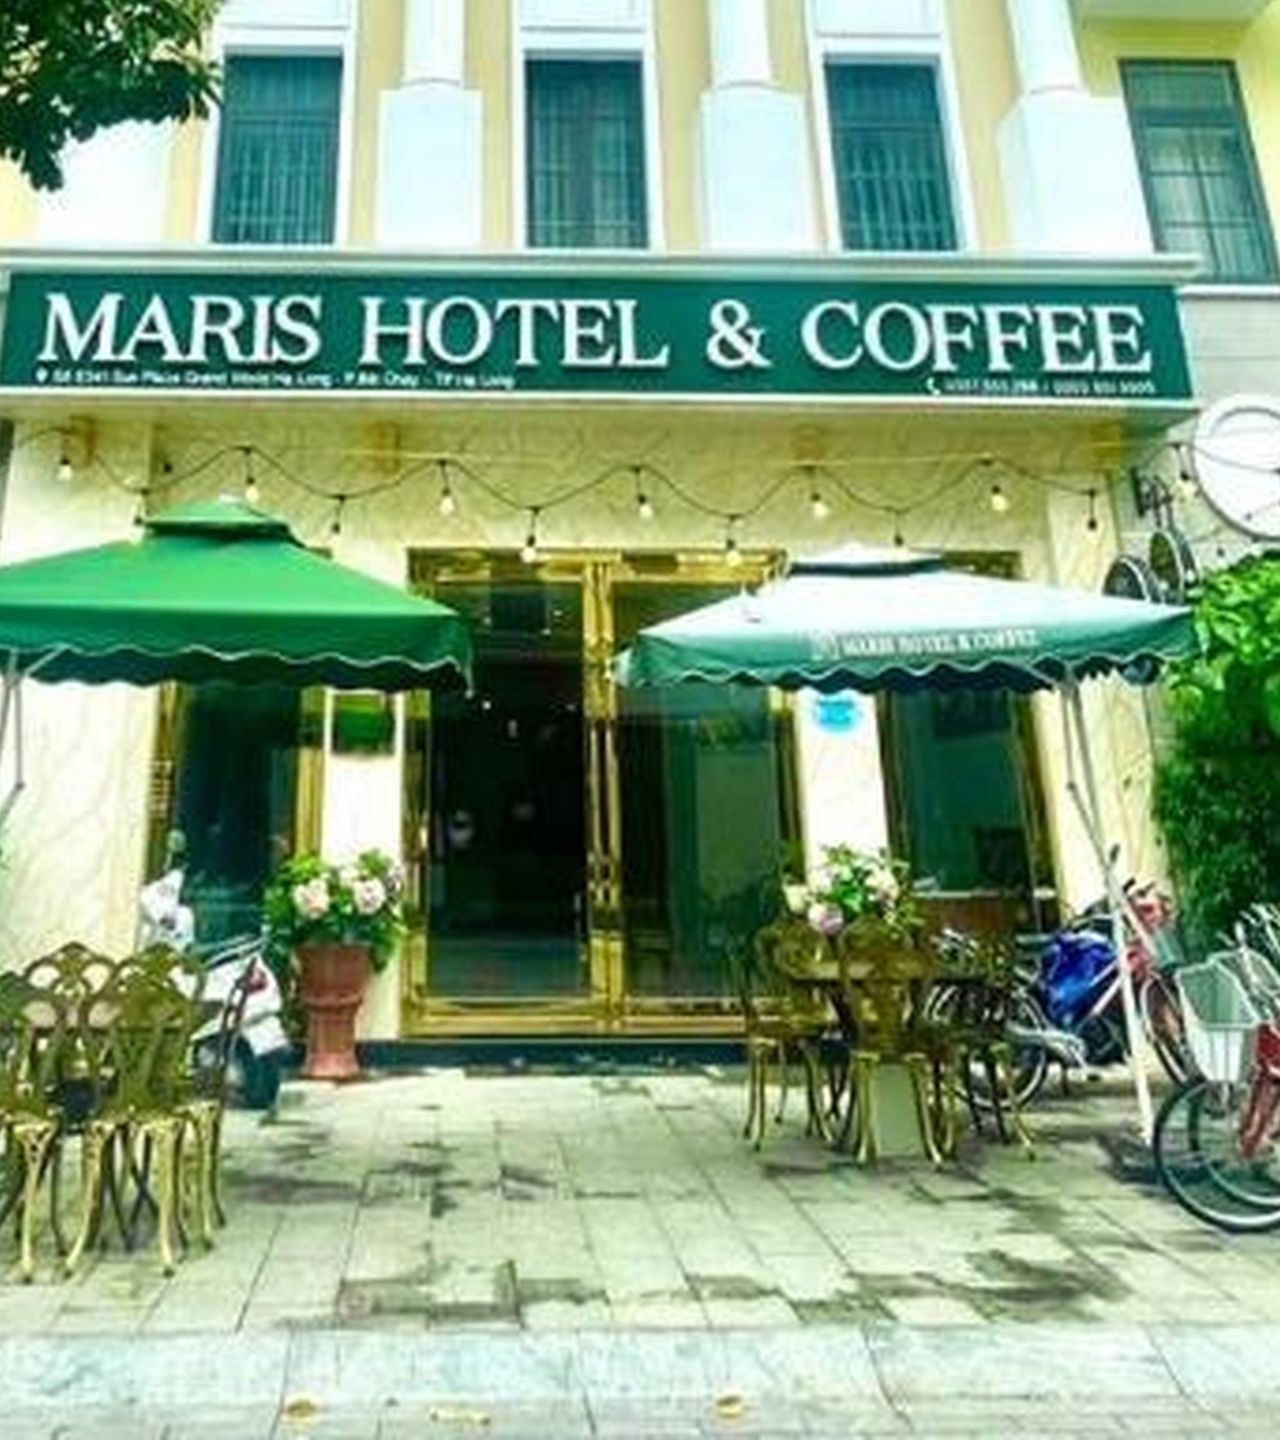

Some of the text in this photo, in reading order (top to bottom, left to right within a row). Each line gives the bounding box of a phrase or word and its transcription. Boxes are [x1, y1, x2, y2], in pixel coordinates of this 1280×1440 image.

[36, 291, 1152, 374] MARIS HOTEL & COFFEE
